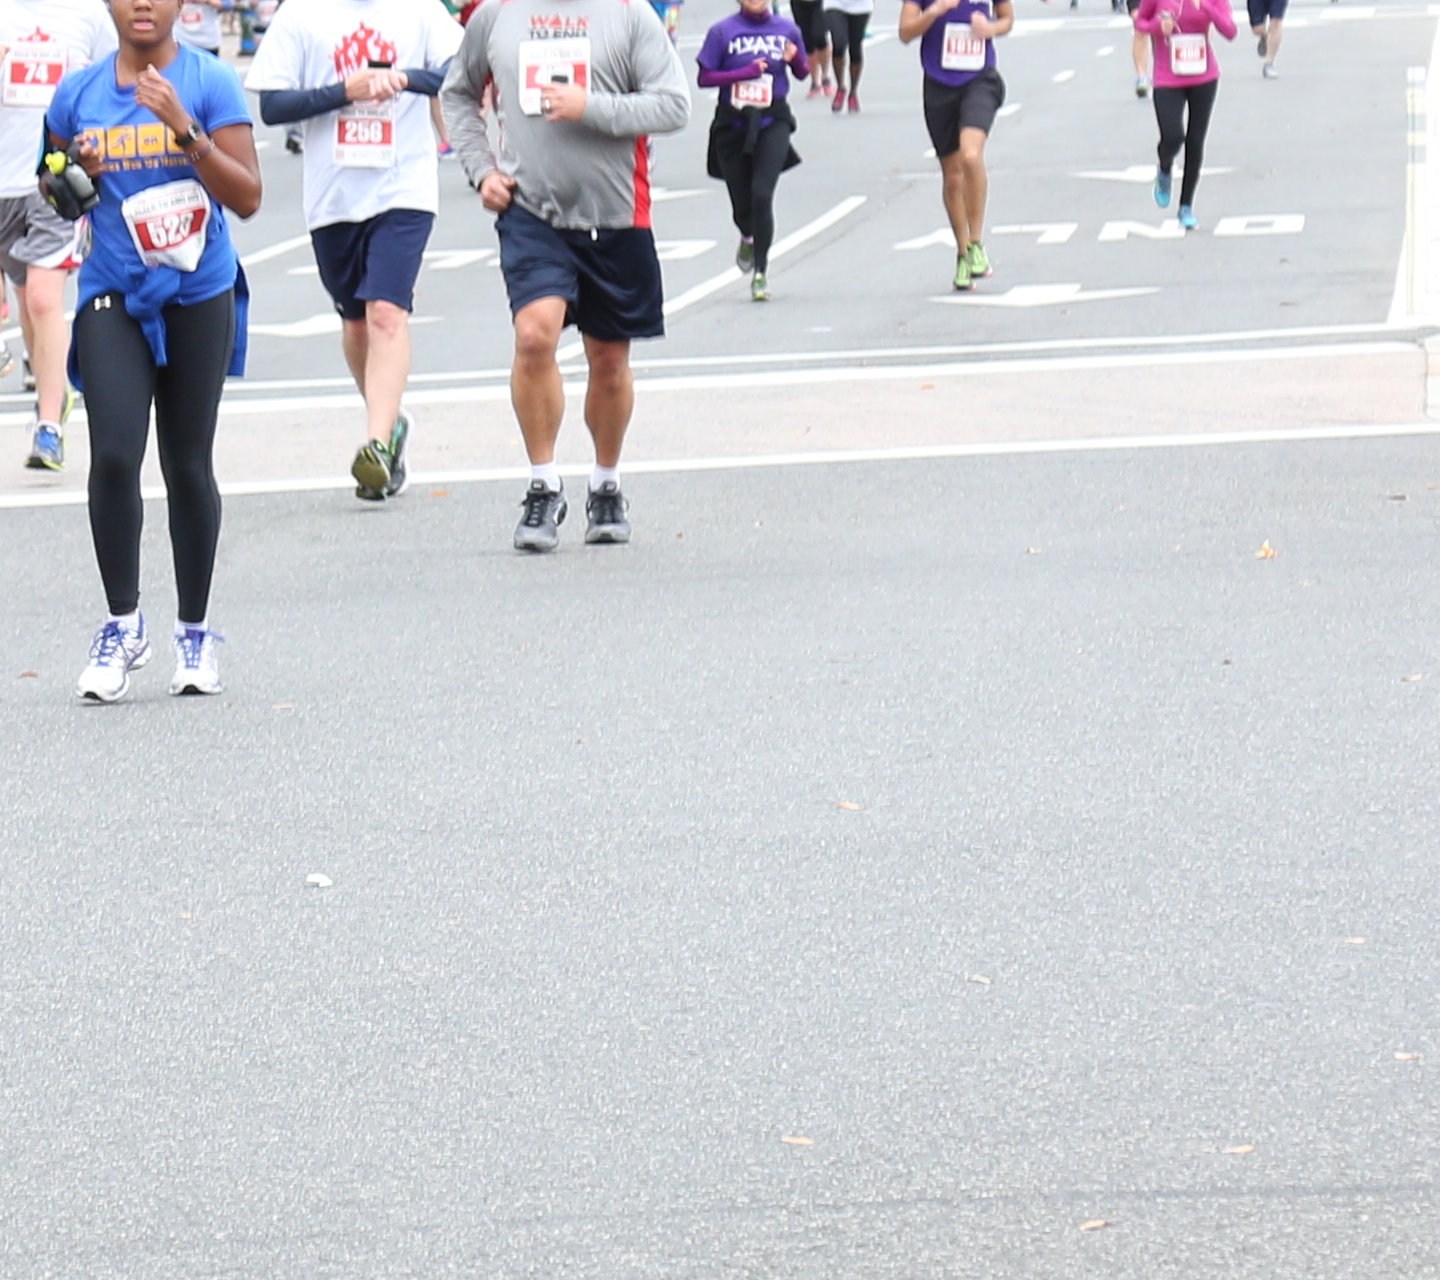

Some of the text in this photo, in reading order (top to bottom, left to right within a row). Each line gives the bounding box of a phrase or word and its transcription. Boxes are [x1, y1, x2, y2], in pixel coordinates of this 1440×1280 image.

[530, 13, 589, 29] WALK
[728, 34, 787, 55] HYATT
[24, 62, 49, 83] 74
